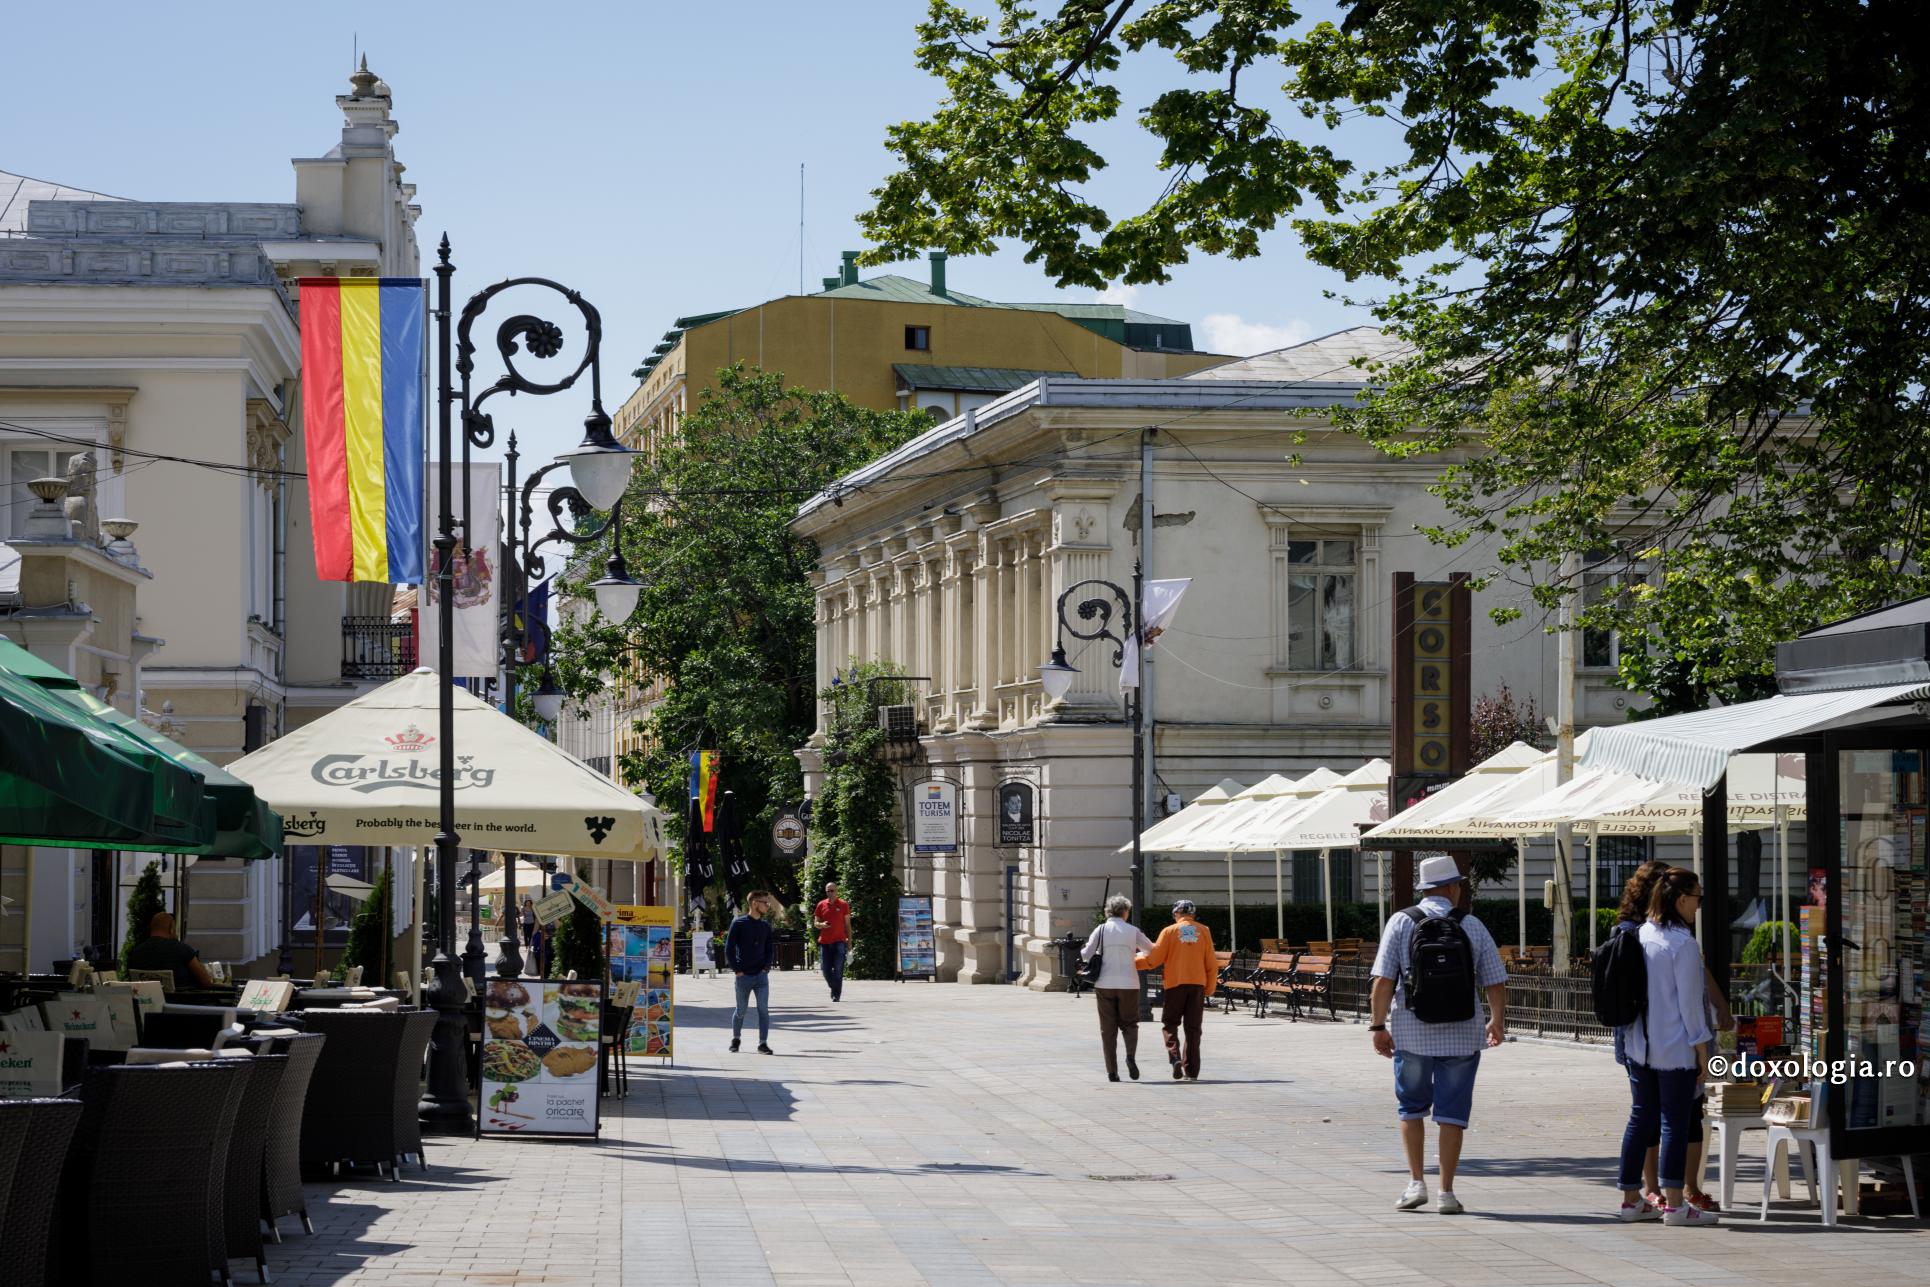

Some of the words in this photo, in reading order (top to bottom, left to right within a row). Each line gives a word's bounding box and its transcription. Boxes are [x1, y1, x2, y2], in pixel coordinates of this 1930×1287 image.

[1419, 590, 1446, 767] CORSO
[919, 801, 951, 810] TOTEM
[355, 818, 403, 829] Probably
[405, 818, 422, 828] the
[424, 819, 441, 829] bes
[455, 822, 472, 830] eer
[474, 822, 483, 831] in
[486, 822, 503, 832] the
[505, 823, 537, 833] world.
[1299, 832, 1348, 841] REGELE
[556, 1099, 585, 1107] pachet
[545, 1108, 585, 1116] oricare
